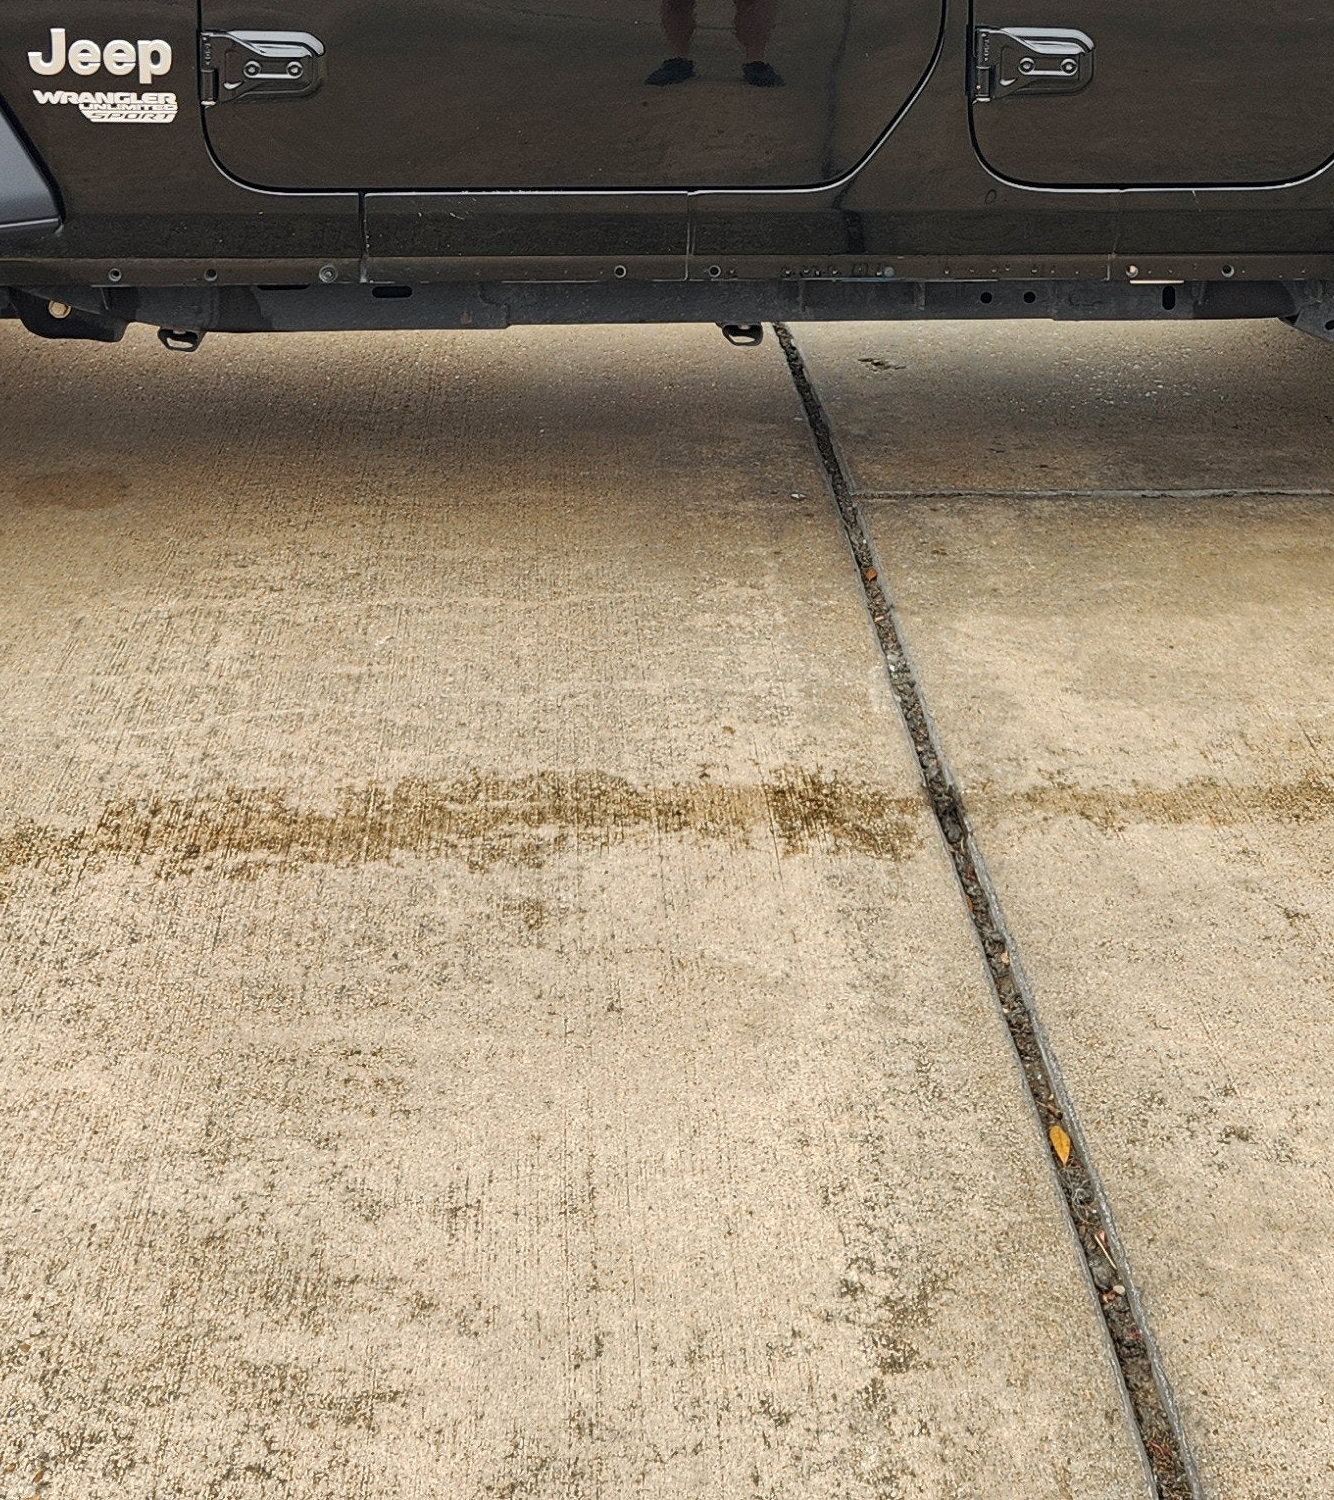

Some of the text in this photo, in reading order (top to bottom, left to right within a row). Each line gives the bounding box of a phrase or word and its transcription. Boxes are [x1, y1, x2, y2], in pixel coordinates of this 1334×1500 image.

[27, 27, 173, 84] Jeep
[32, 89, 177, 105] WRANGLER
[79, 103, 178, 111] UNLIMITED
[88, 111, 176, 121] SPORT
